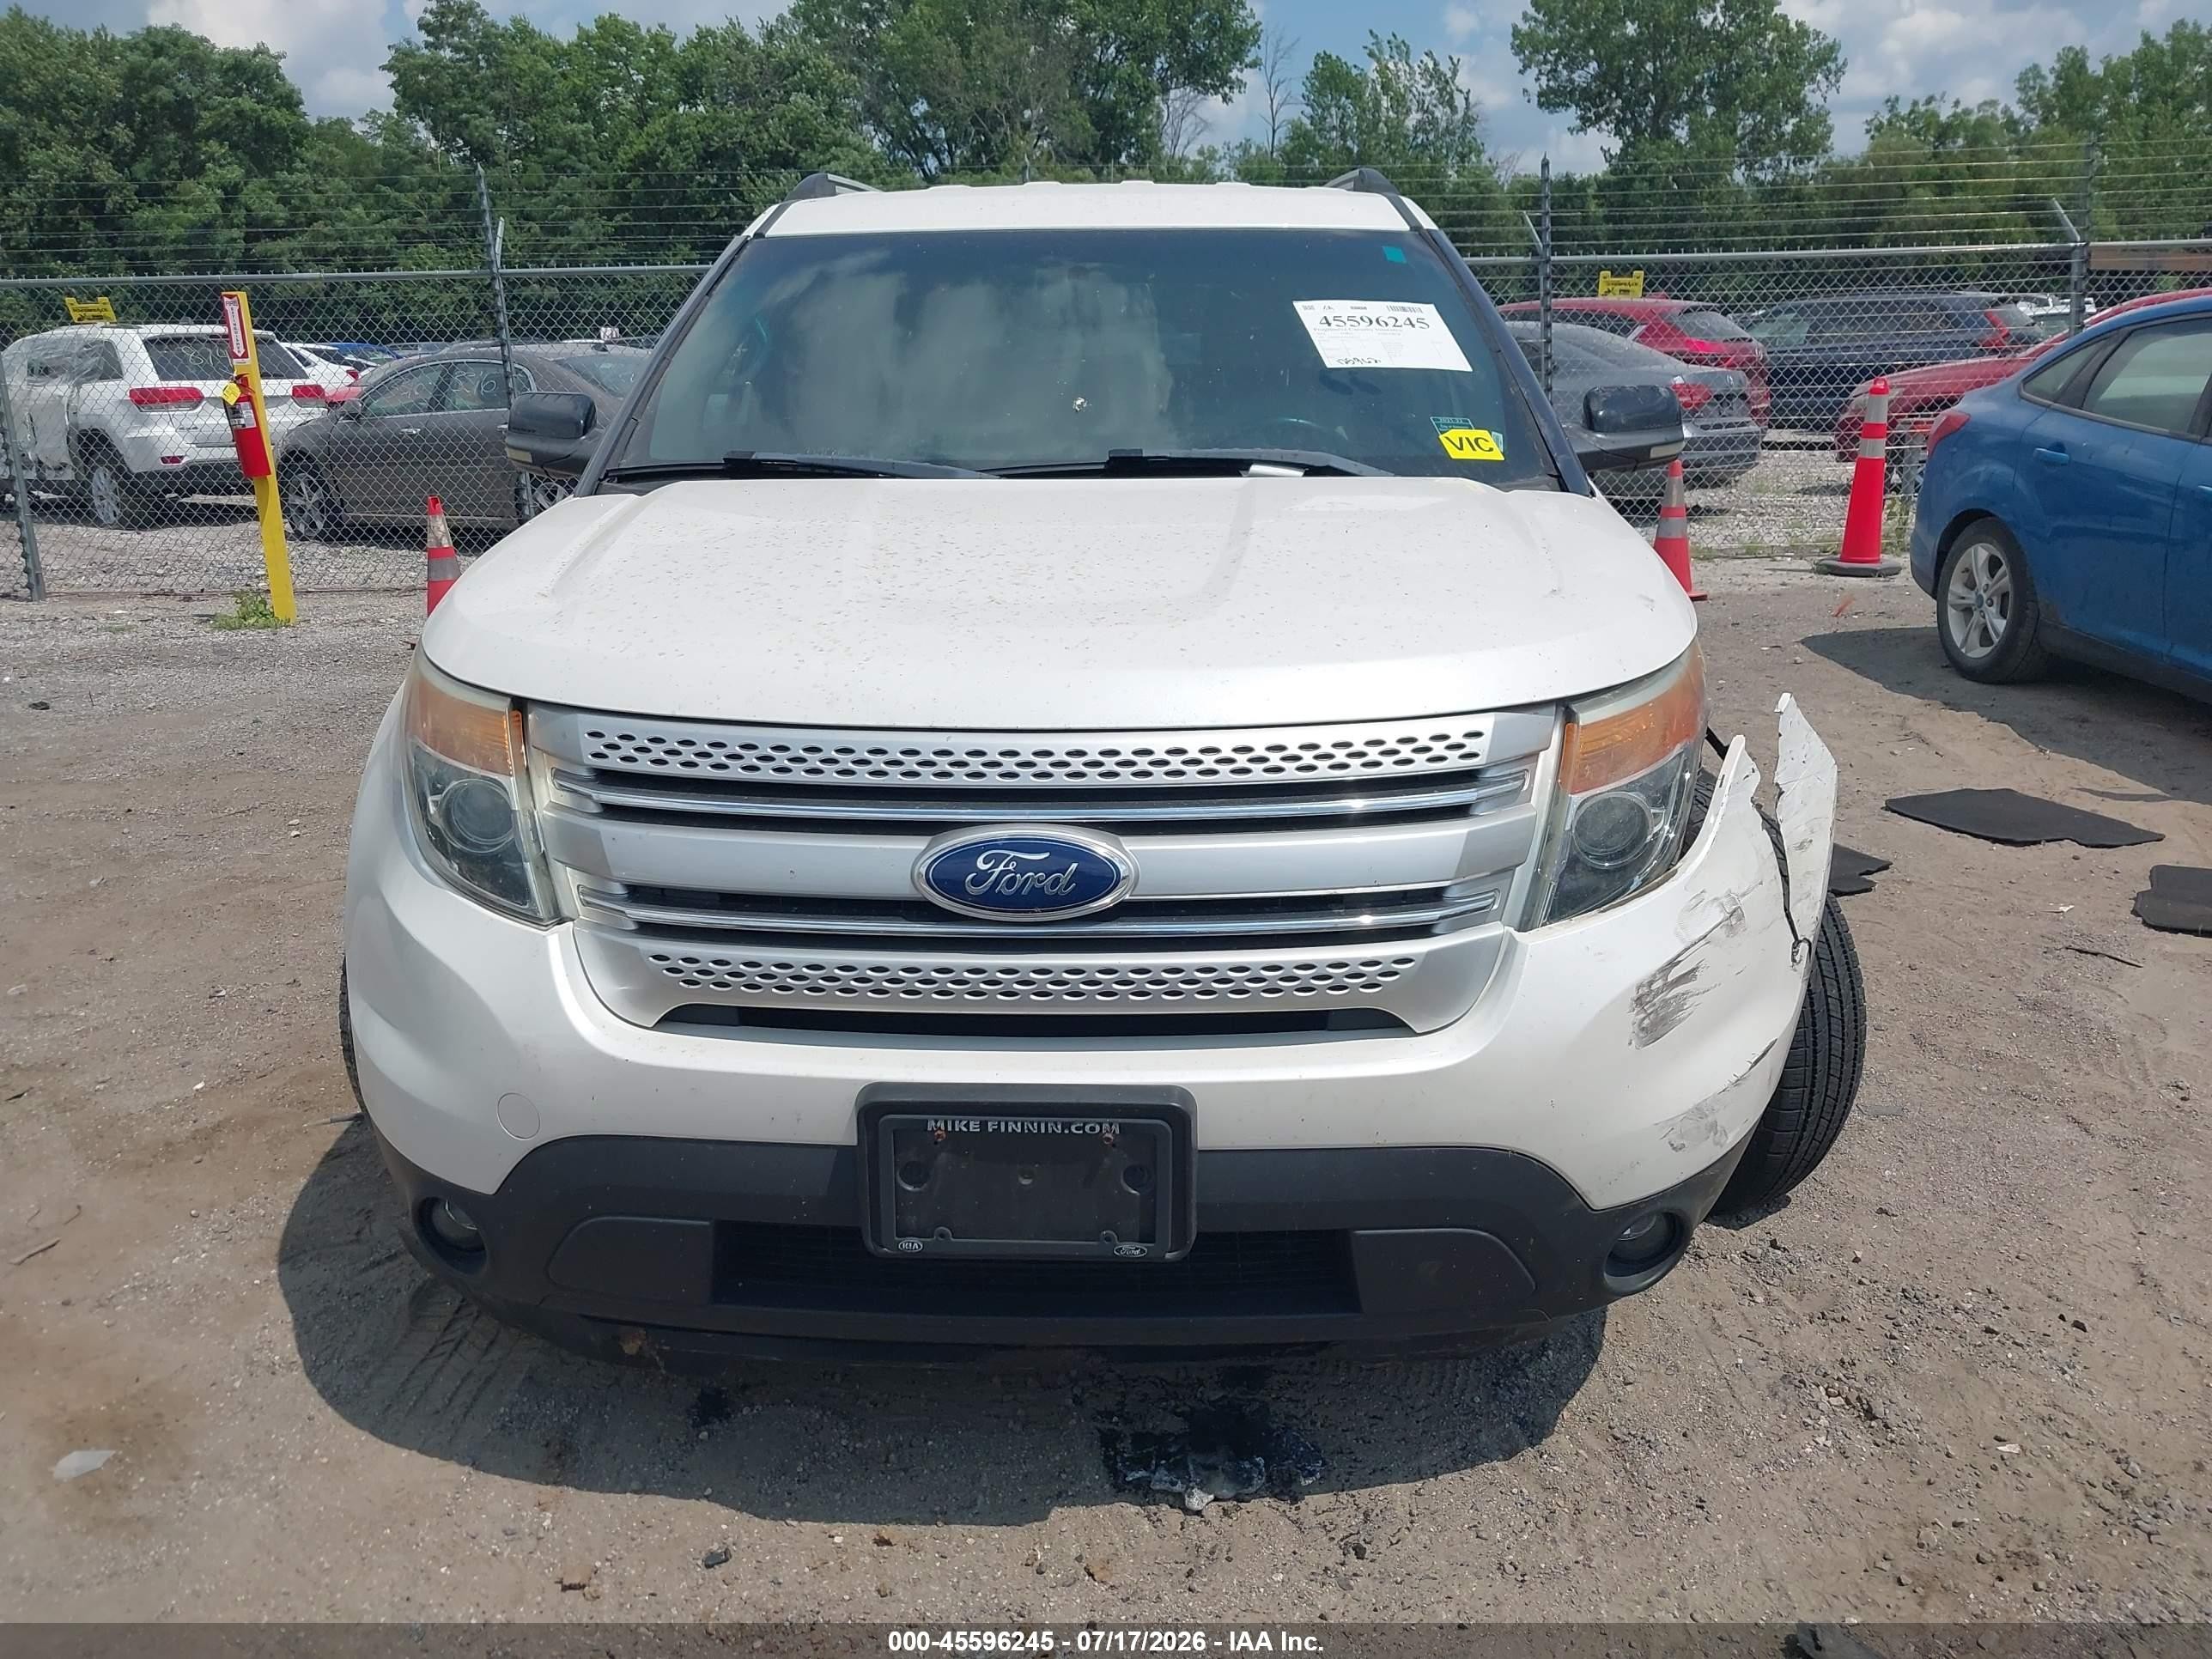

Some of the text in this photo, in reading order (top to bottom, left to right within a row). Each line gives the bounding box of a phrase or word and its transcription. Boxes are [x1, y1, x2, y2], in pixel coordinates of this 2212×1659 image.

[1319, 315, 1430, 330] 45596245
[1444, 436, 1494, 453] VIC
[965, 849, 1079, 896] Ford
[927, 1119, 1121, 1135] MIKE FINNIN.COM
